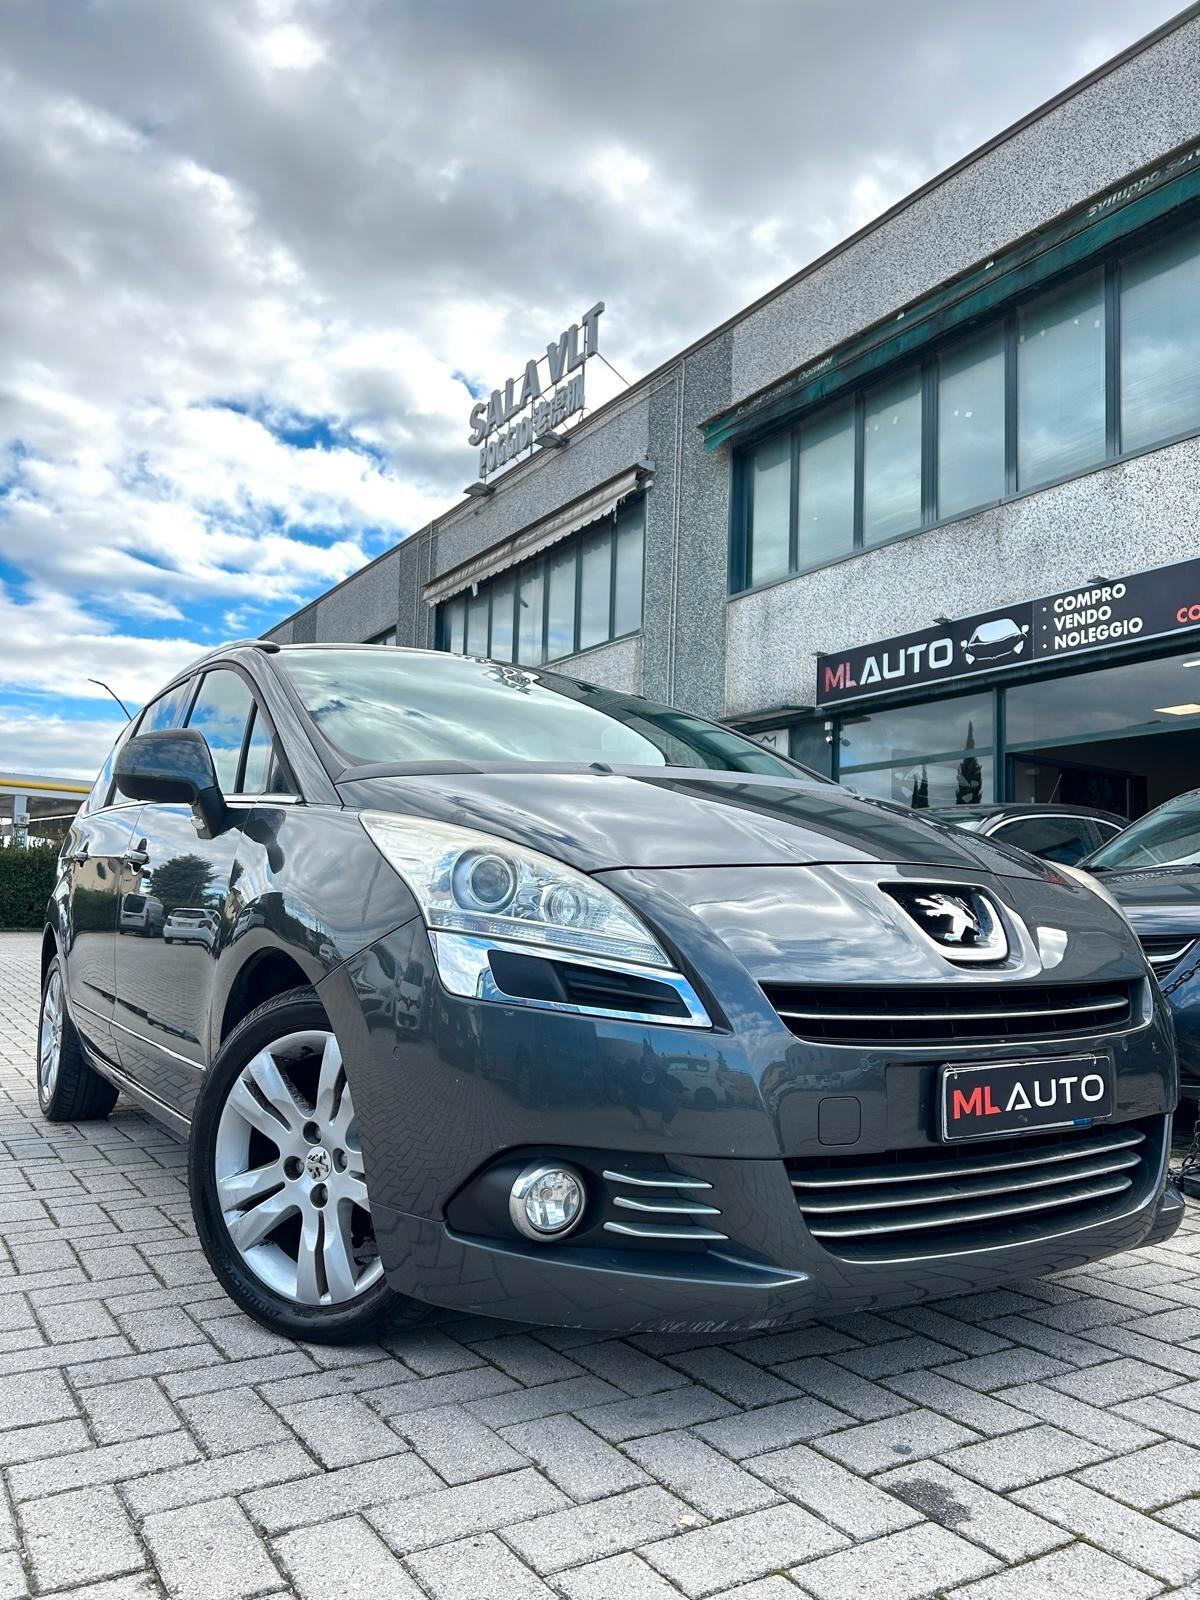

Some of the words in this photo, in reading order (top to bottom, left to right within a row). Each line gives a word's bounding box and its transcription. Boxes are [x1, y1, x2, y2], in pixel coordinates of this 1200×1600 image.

[1086, 170, 1161, 217] Sviluppo
[467, 359, 541, 447] SALA
[546, 300, 605, 385] VLT
[1053, 583, 1127, 613] COMPRO
[1053, 605, 1112, 632] VENDO
[1053, 616, 1144, 651] NOLEGGIO
[824, 662, 857, 693] ML
[860, 637, 953, 686] AUTO
[953, 1085, 1002, 1120] ML
[1005, 1073, 1105, 1112] AUTO
